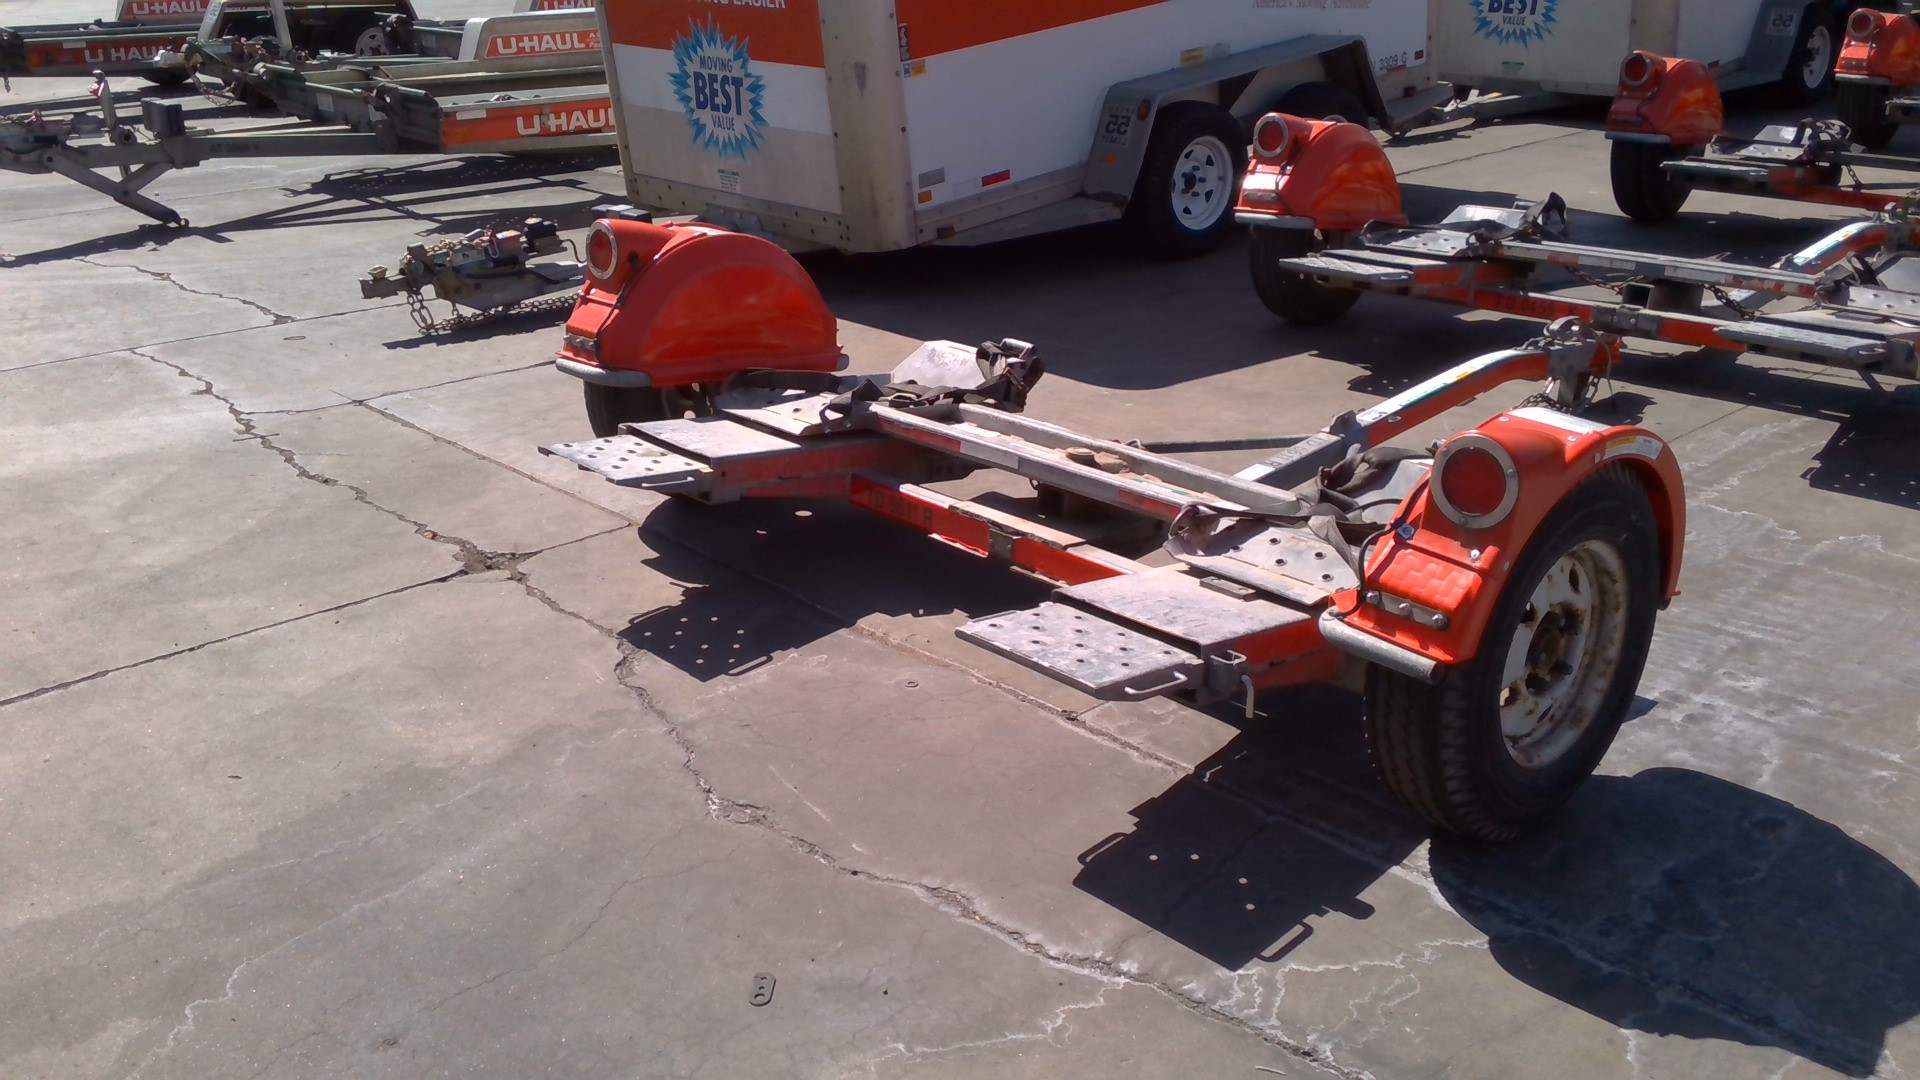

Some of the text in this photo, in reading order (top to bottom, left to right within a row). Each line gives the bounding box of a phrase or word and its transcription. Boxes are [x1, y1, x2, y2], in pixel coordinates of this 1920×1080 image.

[132, 1, 208, 15] U-HAUL
[1502, 15, 1527, 26] VALUE
[496, 32, 586, 54] U-HAUL
[699, 55, 733, 73] MOVING
[1401, 51, 1408, 64] G
[692, 71, 744, 116] BEST
[711, 114, 736, 131] VALUE
